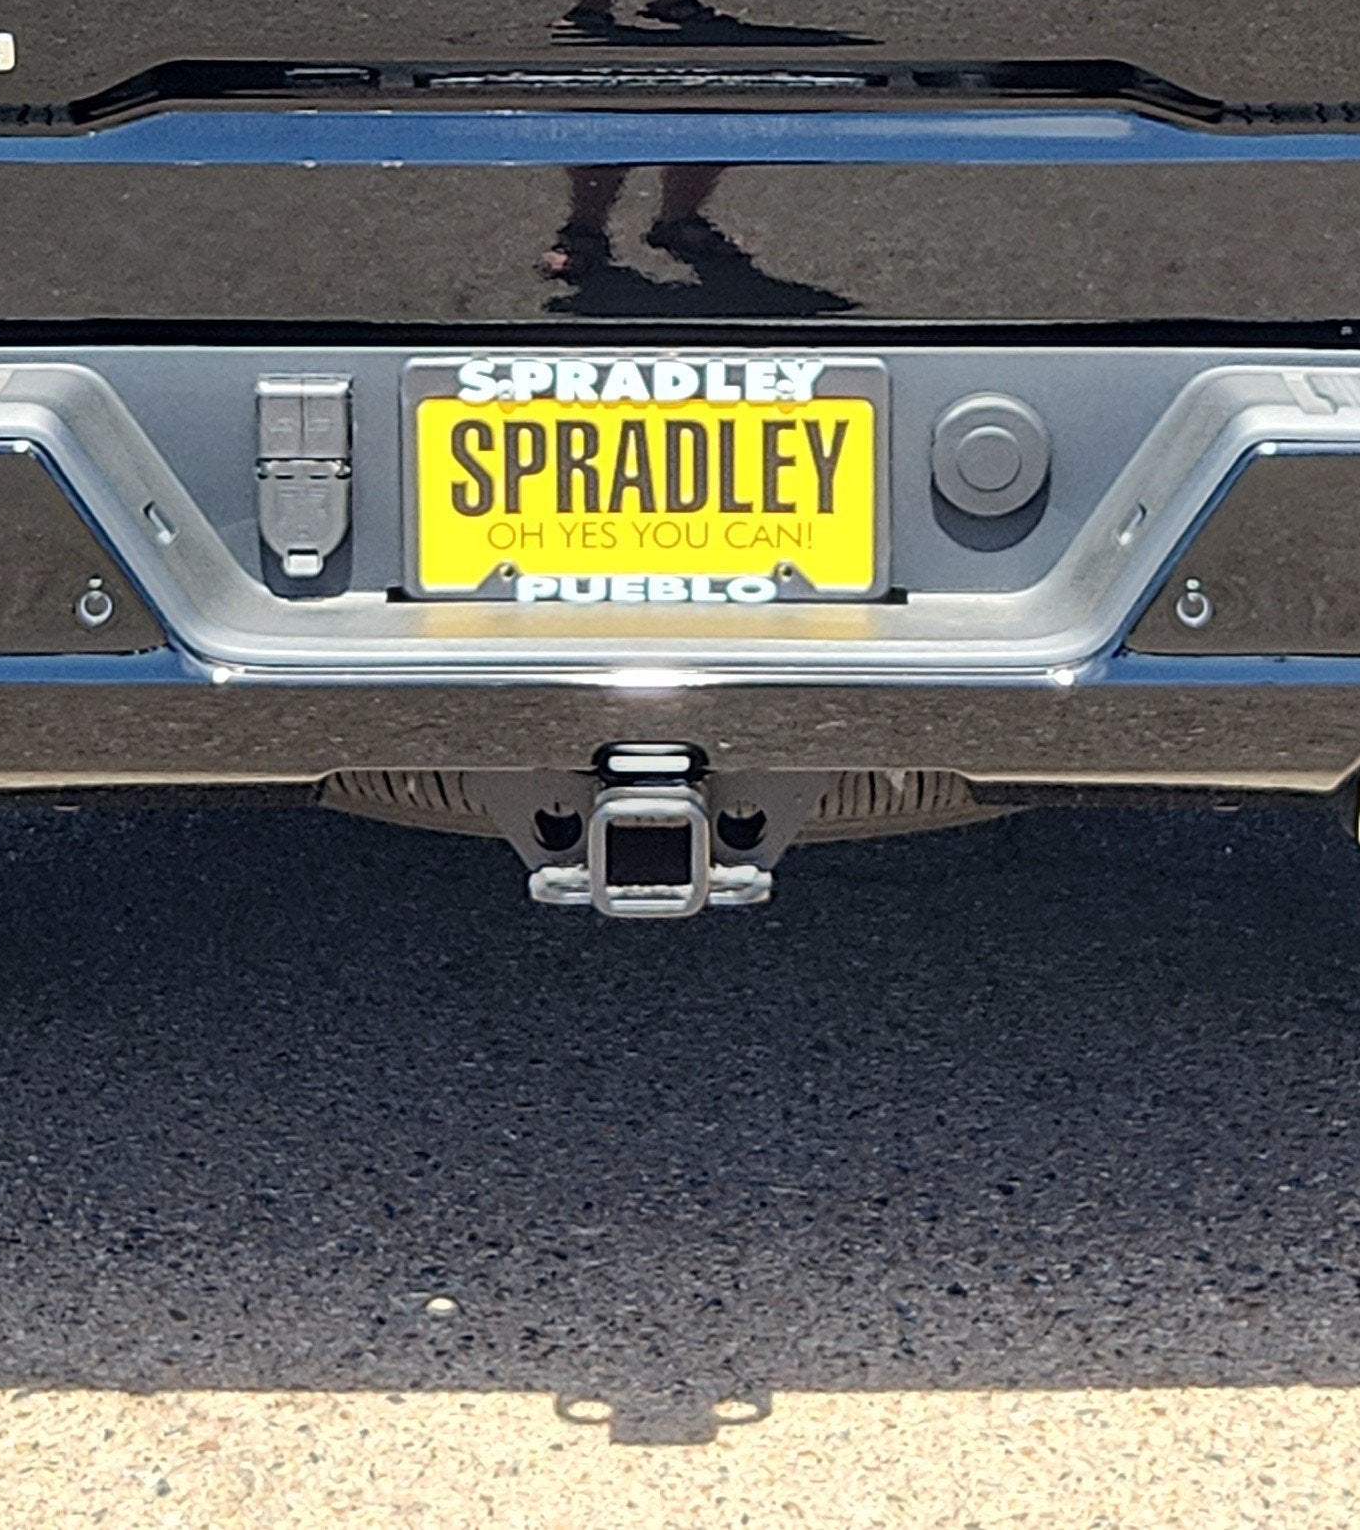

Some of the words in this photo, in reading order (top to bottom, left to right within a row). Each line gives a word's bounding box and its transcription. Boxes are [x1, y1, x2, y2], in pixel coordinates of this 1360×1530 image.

[457, 359, 825, 402] SPRADLEY
[450, 419, 850, 518] SPRADLEY
[487, 521, 544, 550] OH
[559, 521, 618, 550] YES
[632, 521, 709, 550] YOU
[724, 521, 814, 550] CAN!
[516, 575, 779, 604] PUEBLO
